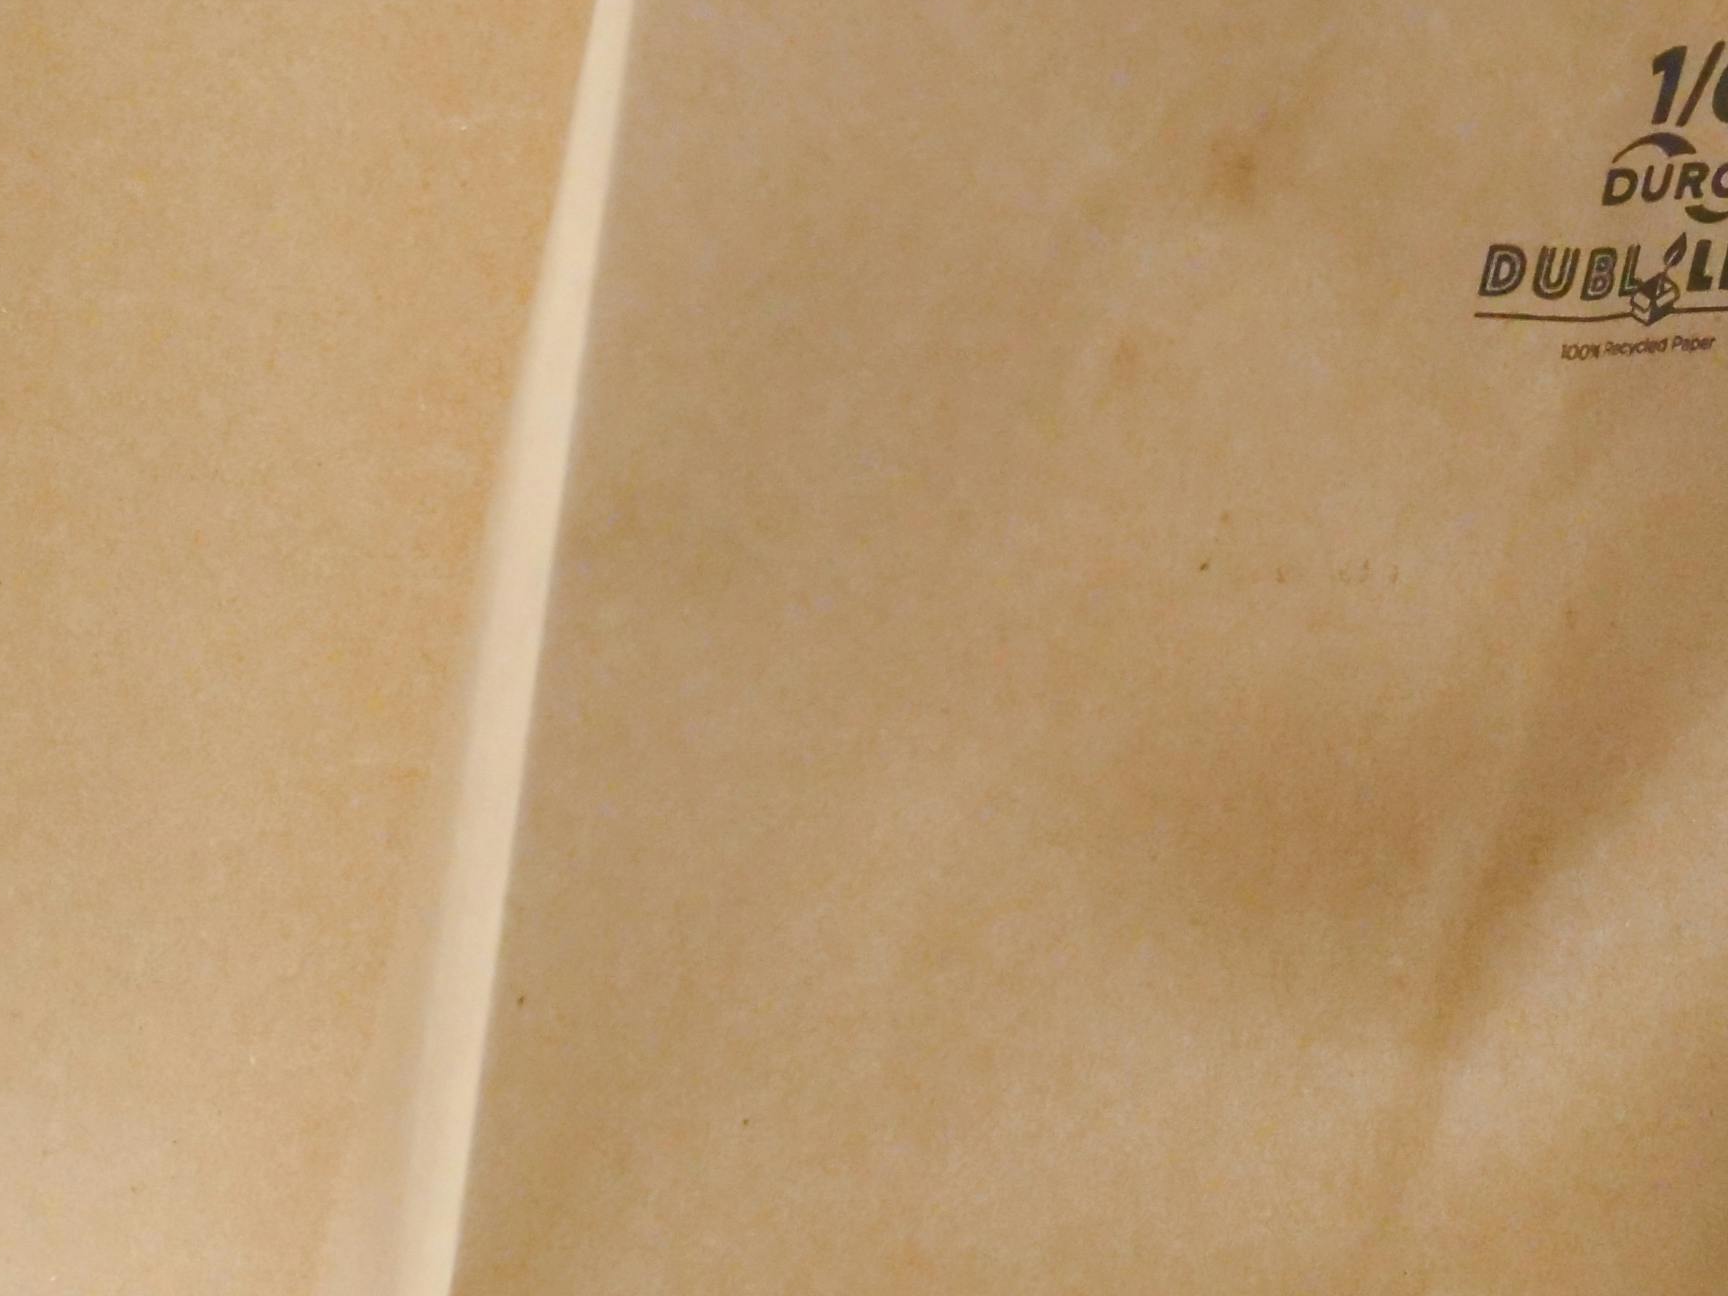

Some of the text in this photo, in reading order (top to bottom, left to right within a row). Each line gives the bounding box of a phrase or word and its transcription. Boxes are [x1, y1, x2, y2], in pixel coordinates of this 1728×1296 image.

[1478, 243, 1645, 301] DUBL
[1560, 335, 1716, 360] 100% Recycled Paper
